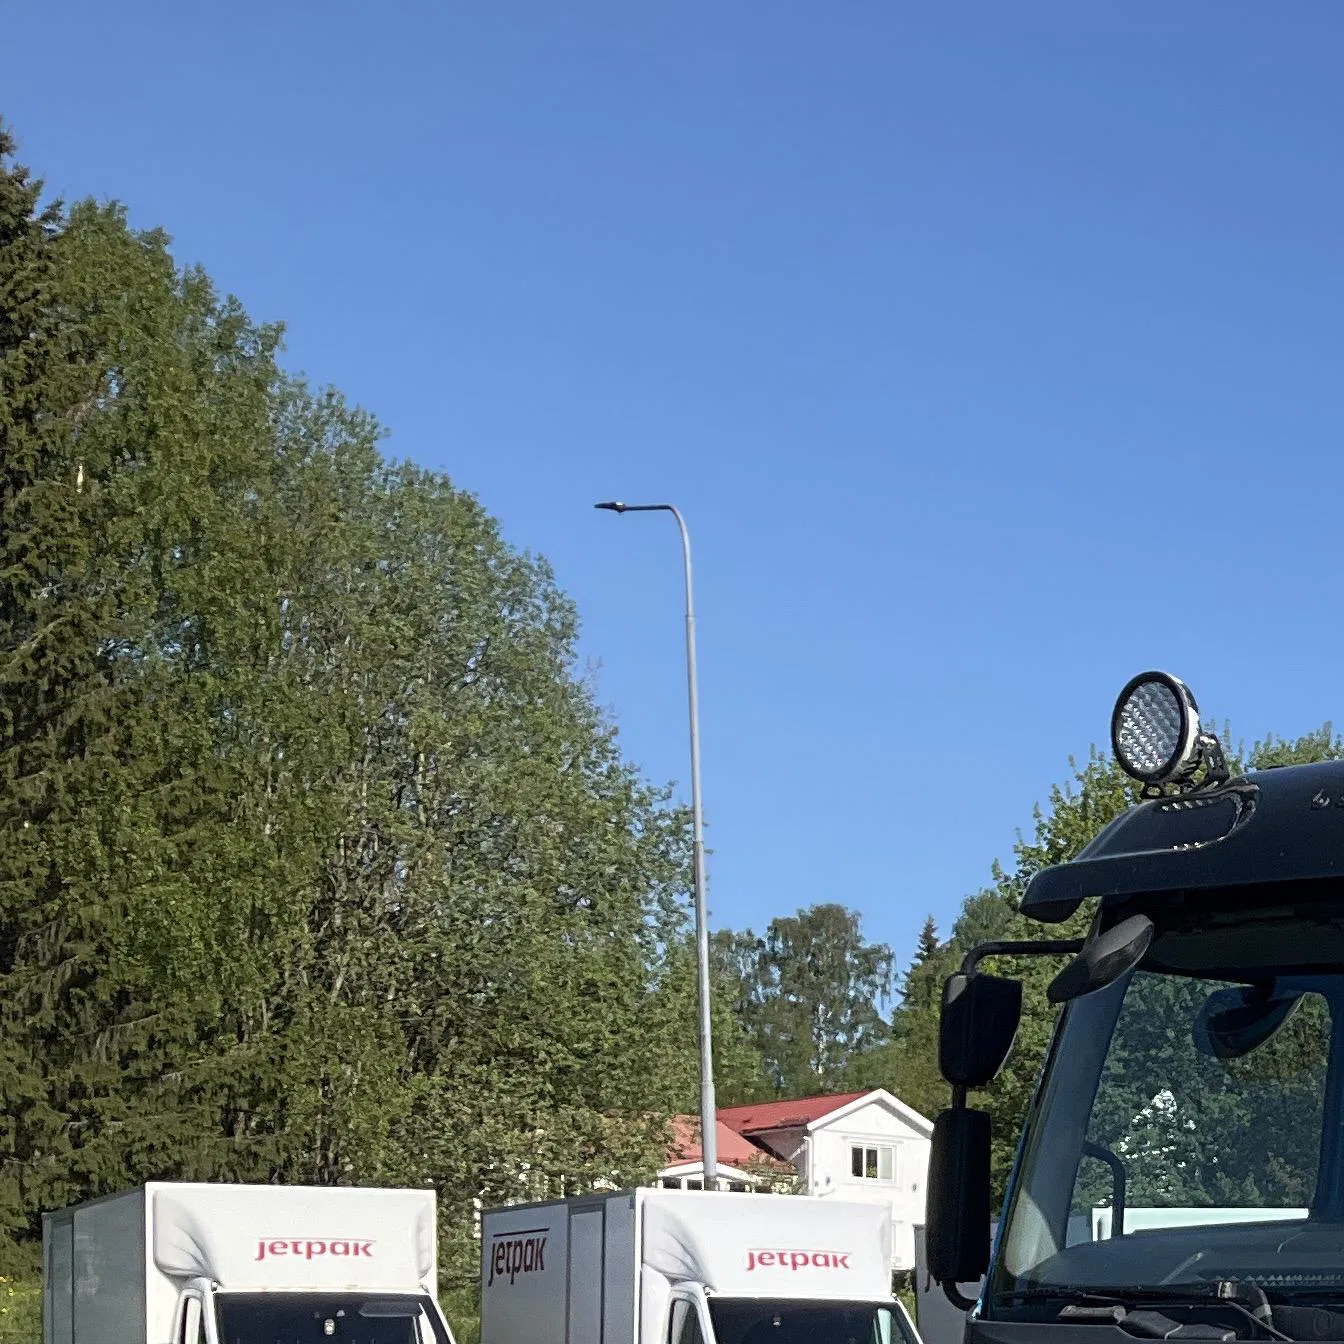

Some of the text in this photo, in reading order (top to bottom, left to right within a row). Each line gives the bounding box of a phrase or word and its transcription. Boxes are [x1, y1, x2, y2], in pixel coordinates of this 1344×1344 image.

[255, 1239, 373, 1261] jetpak
[746, 1251, 849, 1271] jetpak
[487, 1237, 547, 1287] jetpak
